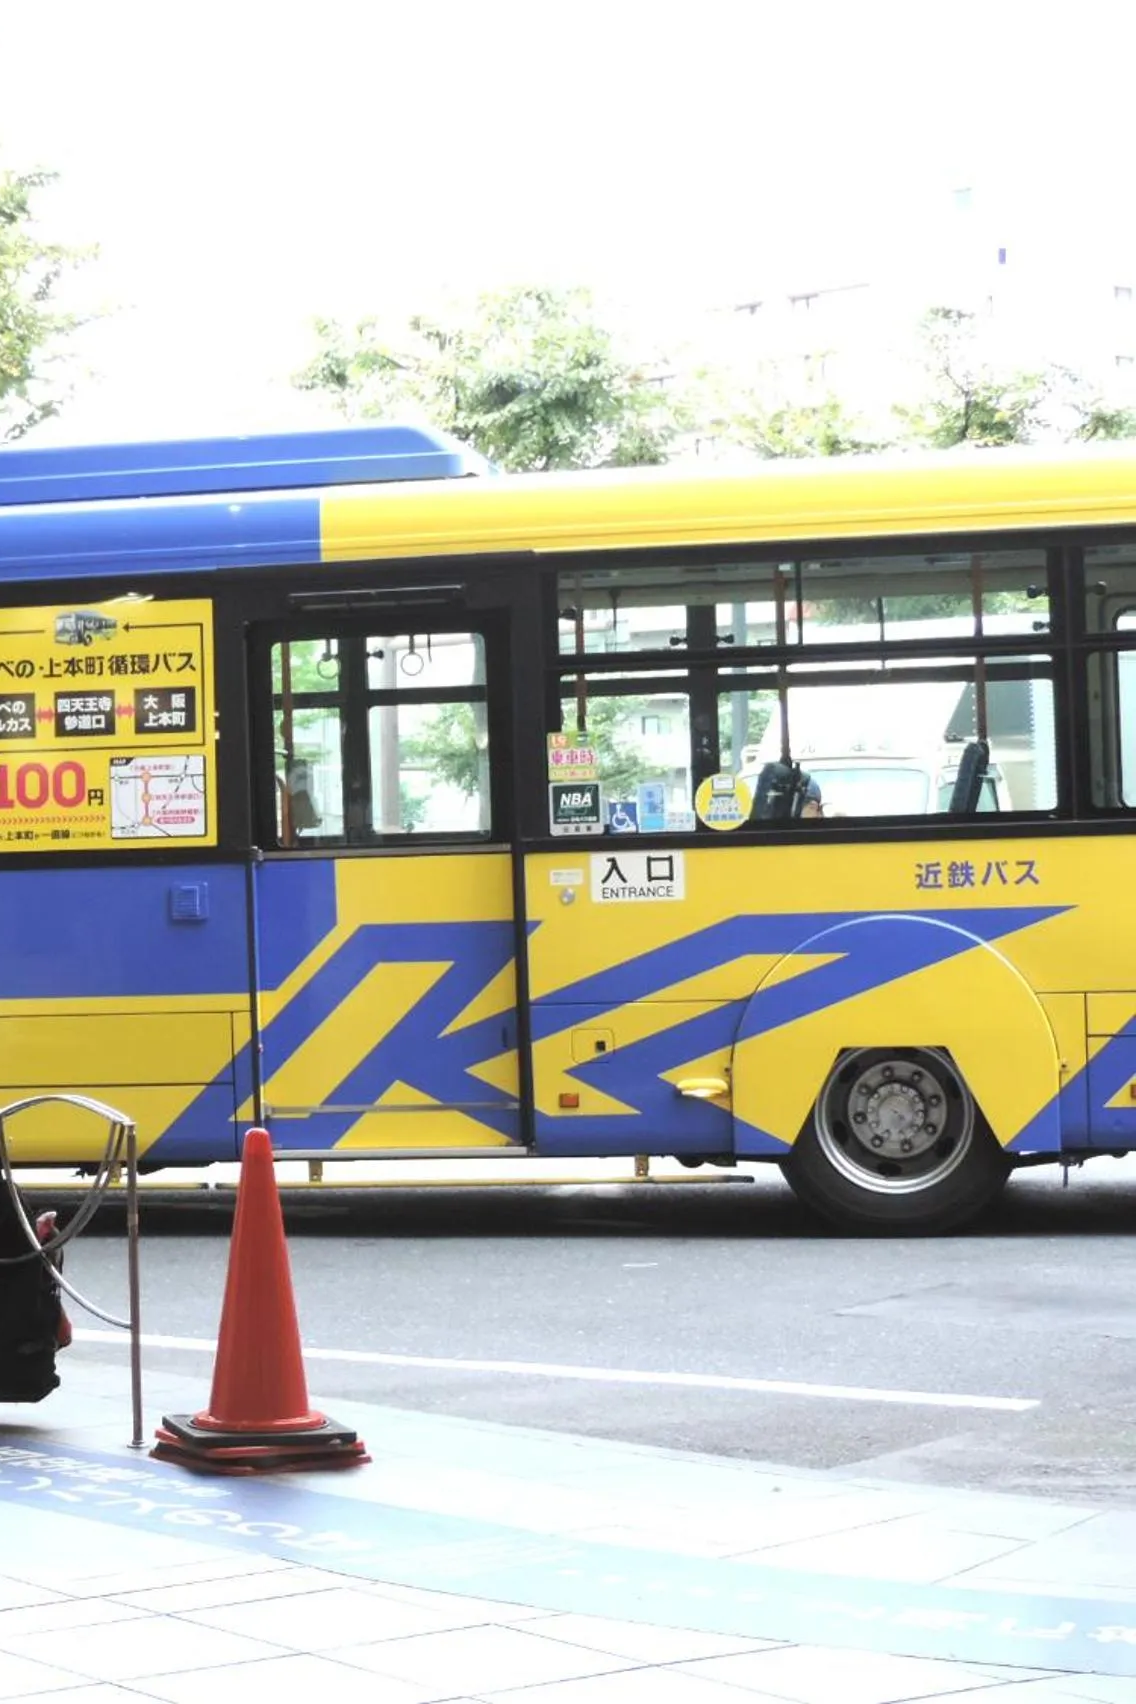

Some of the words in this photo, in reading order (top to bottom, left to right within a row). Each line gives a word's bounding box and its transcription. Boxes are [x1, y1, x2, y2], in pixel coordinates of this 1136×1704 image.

[57, 696, 113, 712] 四天王寺
[143, 693, 186, 710] 大阪
[64, 713, 106, 730] 参道口
[144, 711, 186, 728] 上本町
[560, 793, 593, 808] NBA
[601, 855, 675, 884] 入口
[915, 860, 1040, 889] 近鉄バス
[602, 886, 675, 900] ENTRANCE
